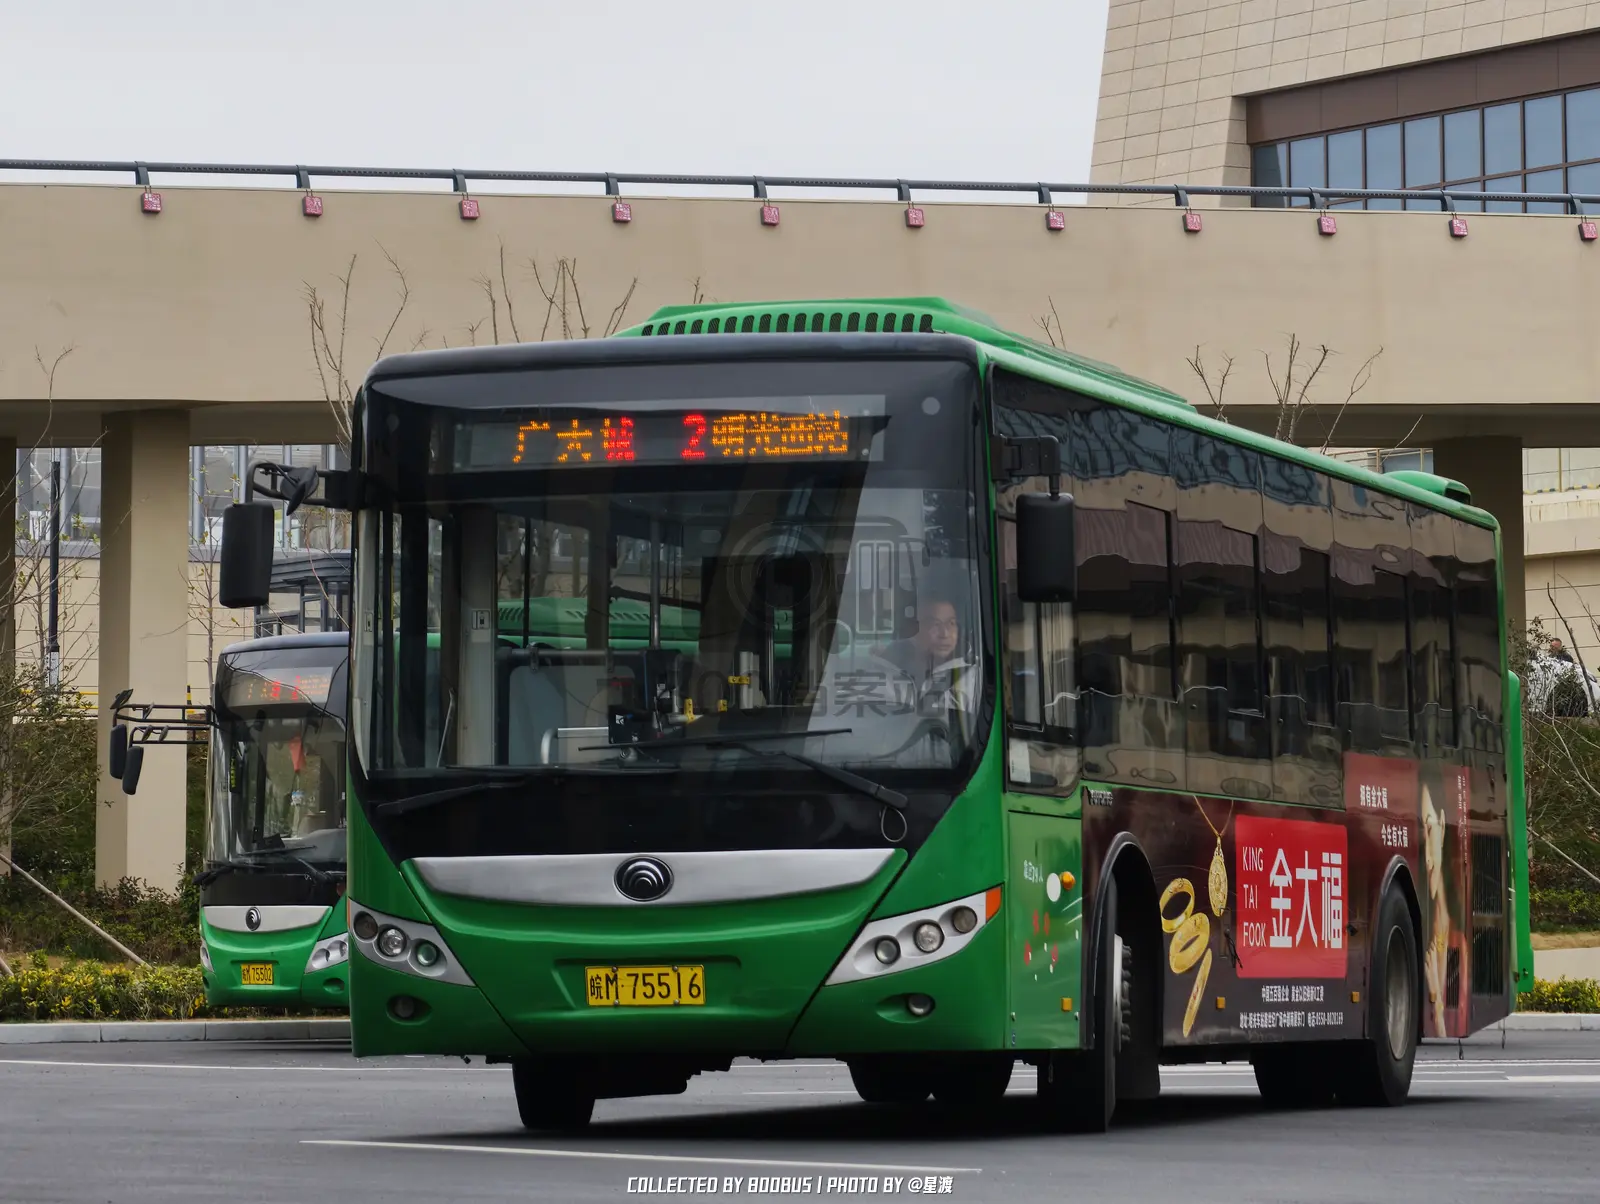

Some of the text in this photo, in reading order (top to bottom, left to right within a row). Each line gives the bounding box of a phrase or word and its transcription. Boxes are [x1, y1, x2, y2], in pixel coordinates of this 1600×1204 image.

[681, 412, 707, 460] 2
[711, 409, 849, 457] 明光西站
[1242, 846, 1264, 872] KING
[1243, 884, 1258, 910] TAI
[1269, 848, 1342, 949] 金大福
[1242, 921, 1267, 947] FOOK
